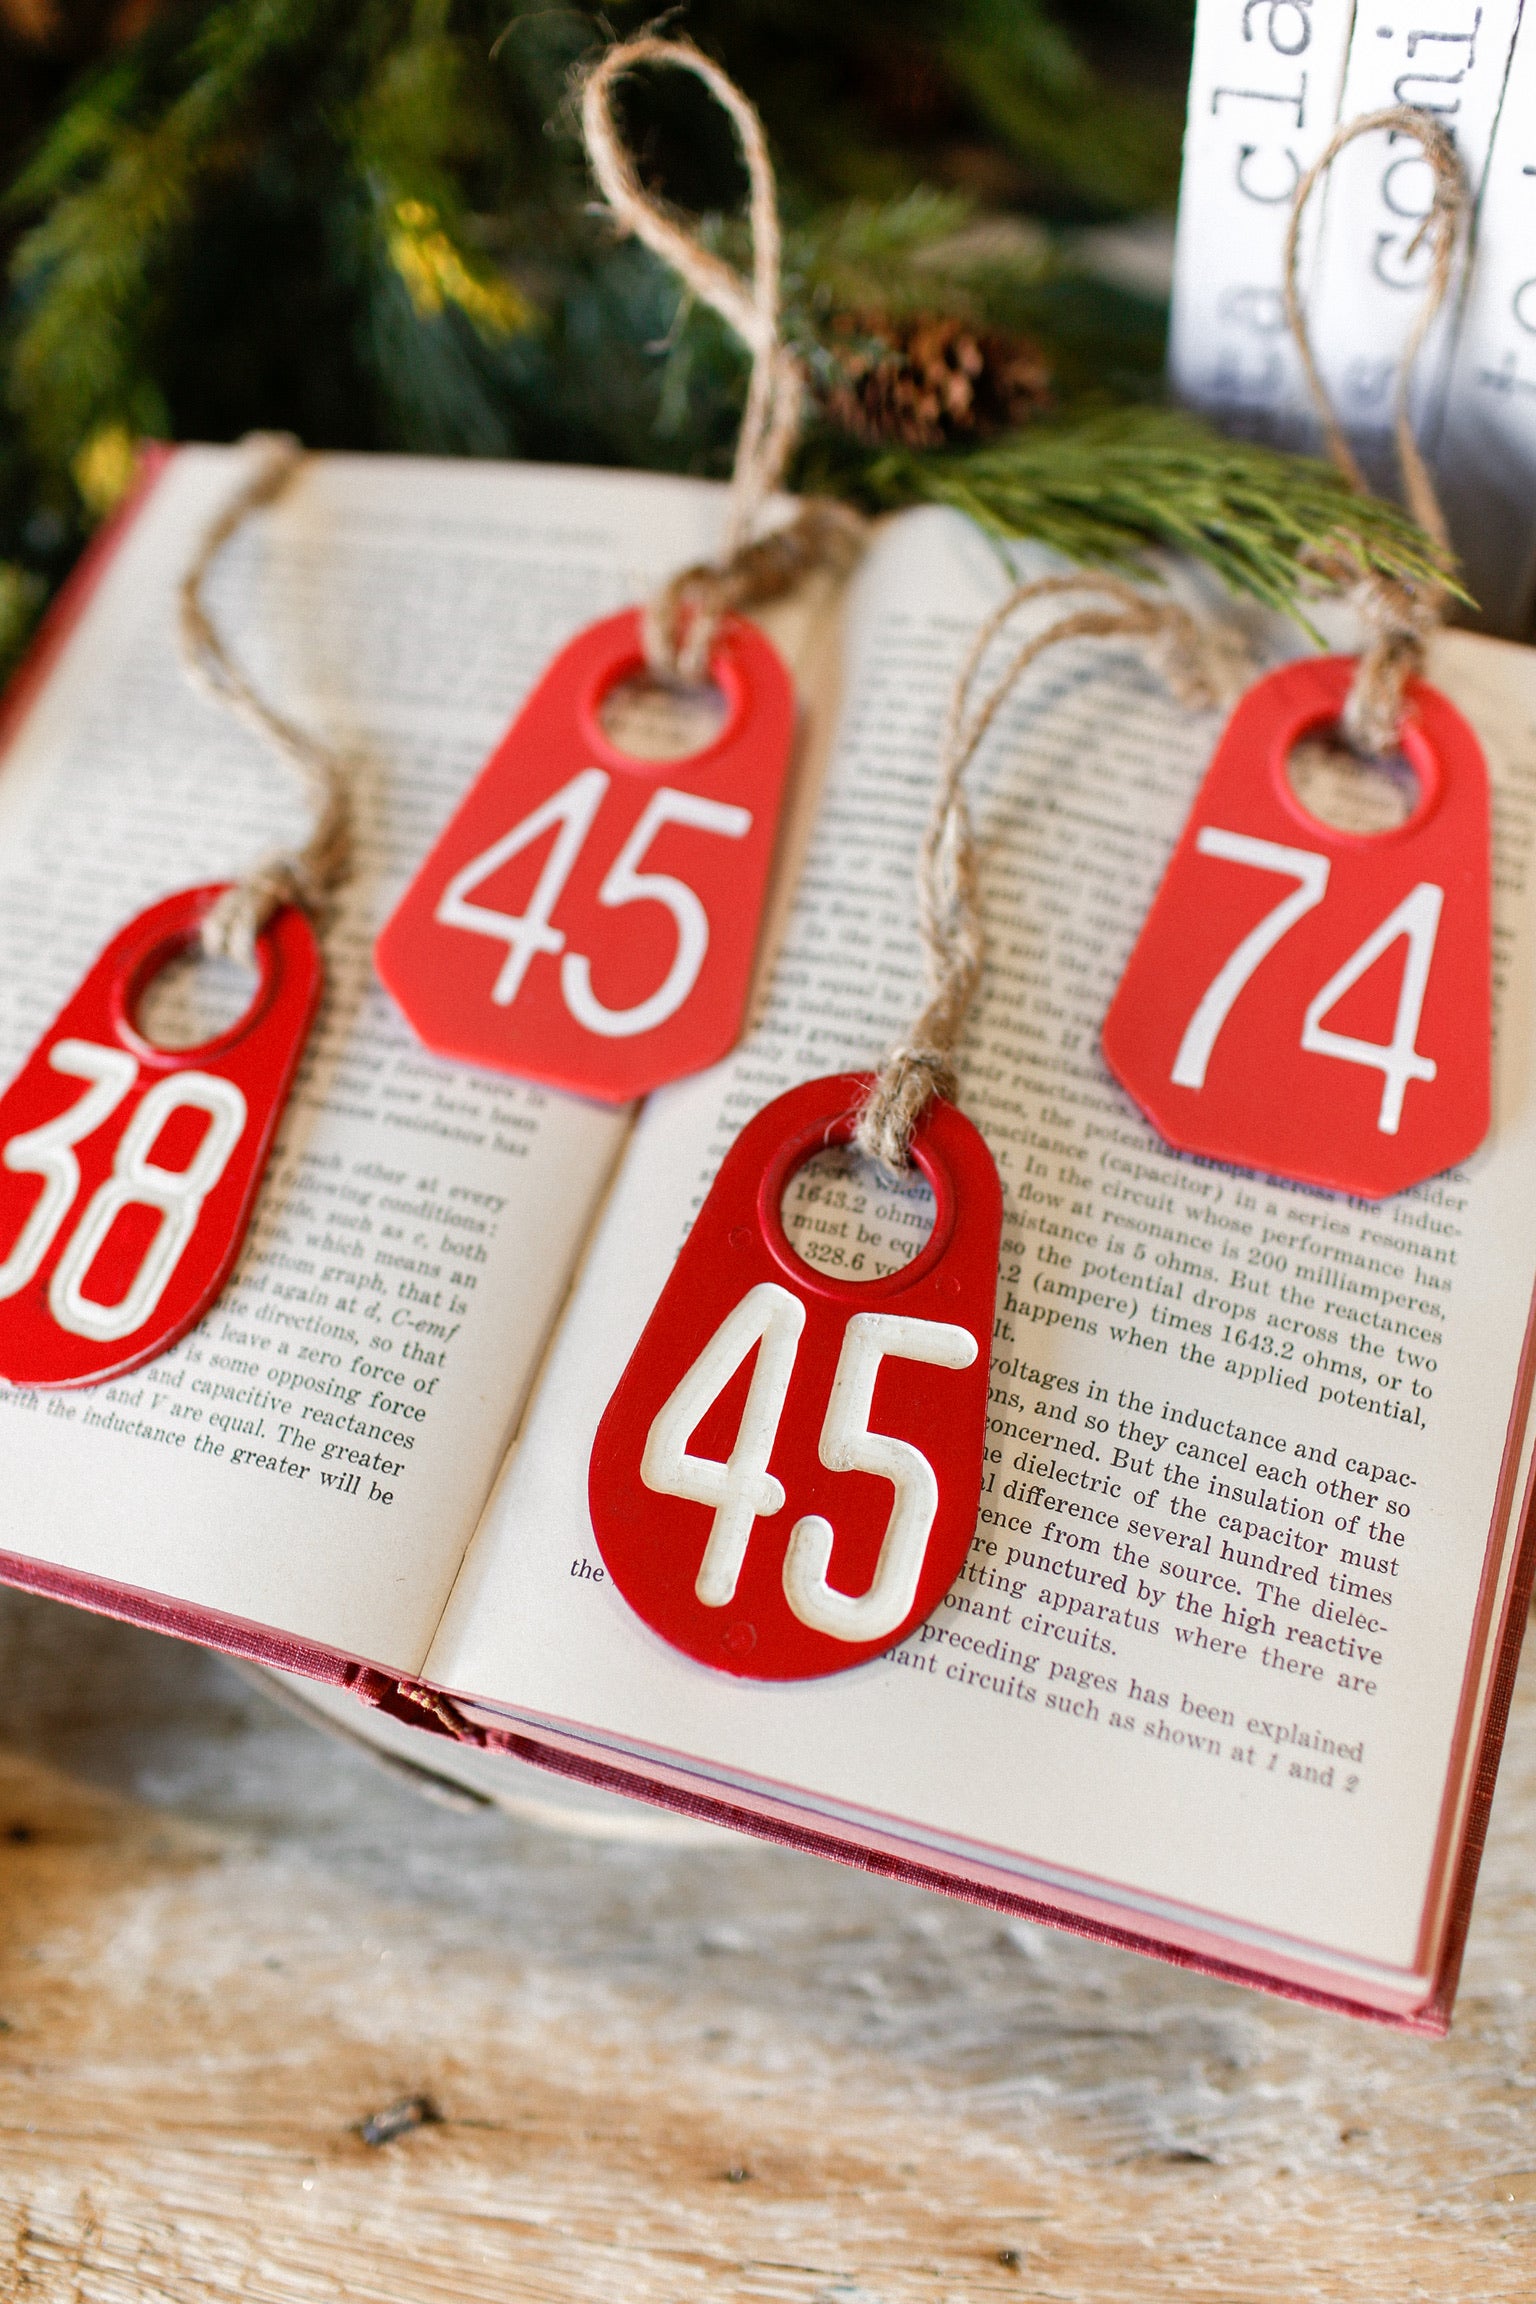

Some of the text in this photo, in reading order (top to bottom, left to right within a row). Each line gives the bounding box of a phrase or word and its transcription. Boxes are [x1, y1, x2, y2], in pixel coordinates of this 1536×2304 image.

[435, 766, 752, 1037] 45
[1170, 825, 1436, 1136] 74
[0, 1040, 248, 1342] 38
[448, 1186, 510, 1214] every
[857, 1223, 882, 1247] be
[1024, 1154, 1452, 1292] In the circuit whose performance has
[1236, 1192, 1256, 1210] in
[1266, 1202, 1278, 1216] a
[1287, 1210, 1350, 1236] series
[1360, 1228, 1456, 1266] resonant
[374, 1250, 442, 1278] means
[449, 1270, 478, 1290] an
[397, 1280, 443, 1309] that
[447, 1294, 468, 1316] is
[440, 1234, 488, 1264] both
[804, 1241, 866, 1271] 328.6
[1018, 1182, 1446, 1322] flow at resonance is 200 milliamperes,
[1106, 1234, 1442, 1345] is 5 ohms. But the reactances
[254, 1302, 448, 1369] directions, so that
[334, 1296, 358, 1314] at
[1000, 1239, 1438, 1372] so the potential drops across the two
[1033, 1272, 1433, 1400] (ampere) times 1643.2 ohms, or to
[208, 1354, 426, 1423] some opposing force
[296, 1346, 342, 1368] zero
[348, 1355, 406, 1386] force
[412, 1376, 440, 1396] of
[1002, 1291, 1426, 1430] happens when the applied potential,
[81, 1406, 186, 1448] inductance
[194, 1433, 225, 1457] the
[229, 1448, 310, 1480] greater
[318, 1471, 366, 1497] will
[366, 1480, 398, 1506] be
[169, 1402, 204, 1422] are
[208, 1412, 265, 1439] equal.
[276, 1423, 316, 1452] The
[320, 1442, 405, 1478] greater
[190, 1378, 292, 1415] capacitive
[300, 1405, 416, 1450] reactances
[640, 1282, 980, 1642] 45
[990, 1356, 1417, 1488] voltages in the inductance and capac-
[1034, 1401, 1410, 1518] and so they cancel each other so
[1003, 1480, 1392, 1606] difference several hundred times
[1013, 1452, 1400, 1576] dielectric of the capacitor must
[1110, 1446, 1155, 1477] But
[1161, 1462, 1200, 1490] the
[1208, 1475, 1324, 1526] insulation
[1334, 1515, 1362, 1534] of
[1368, 1521, 1405, 1547] the
[570, 1558, 605, 1582] the
[1004, 1546, 1383, 1666] punctured by the high reactive
[1040, 1522, 1101, 1556] from
[1113, 1542, 1150, 1569] the
[1159, 1560, 1242, 1596] source.
[1256, 1581, 1300, 1611] The
[1312, 1598, 1388, 1633] dielec-
[919, 1622, 1040, 1674] preceding
[1048, 1661, 1118, 1693] pages
[1128, 1678, 1170, 1708] has
[1180, 1693, 1234, 1727] been
[944, 1592, 1116, 1656] onant circuits.
[1038, 1589, 1160, 1635] apparatus
[1174, 1626, 1247, 1660] where
[1262, 1646, 1324, 1681] there
[1338, 1673, 1377, 1696] are
[946, 1664, 1036, 1702] circuits
[1046, 1694, 1099, 1721] such
[1109, 1712, 1135, 1730] as
